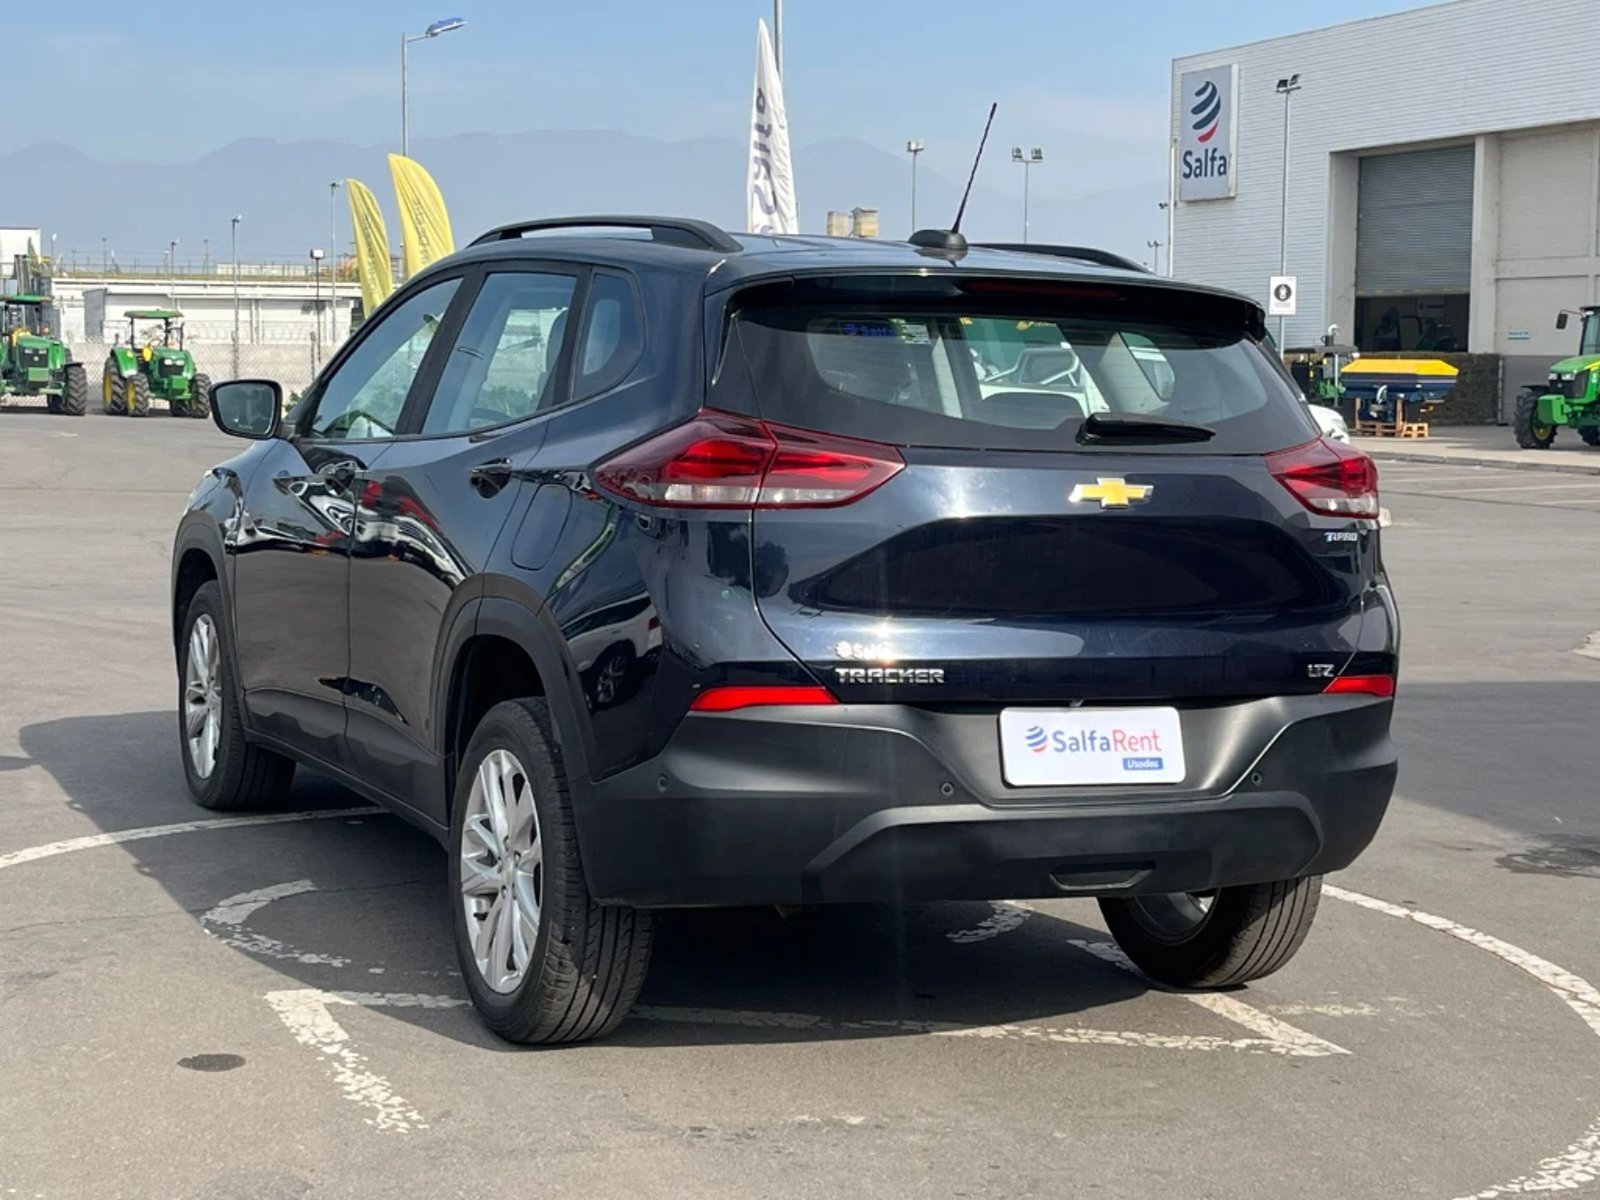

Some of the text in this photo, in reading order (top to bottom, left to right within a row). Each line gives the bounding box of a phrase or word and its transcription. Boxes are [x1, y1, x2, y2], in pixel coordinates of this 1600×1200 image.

[1182, 147, 1227, 179] Salfa
[835, 667, 945, 684] TRACKER
[1307, 663, 1334, 677] LTZ
[1052, 729, 1162, 753] SalfaRent
[1127, 758, 1160, 769] Usados
